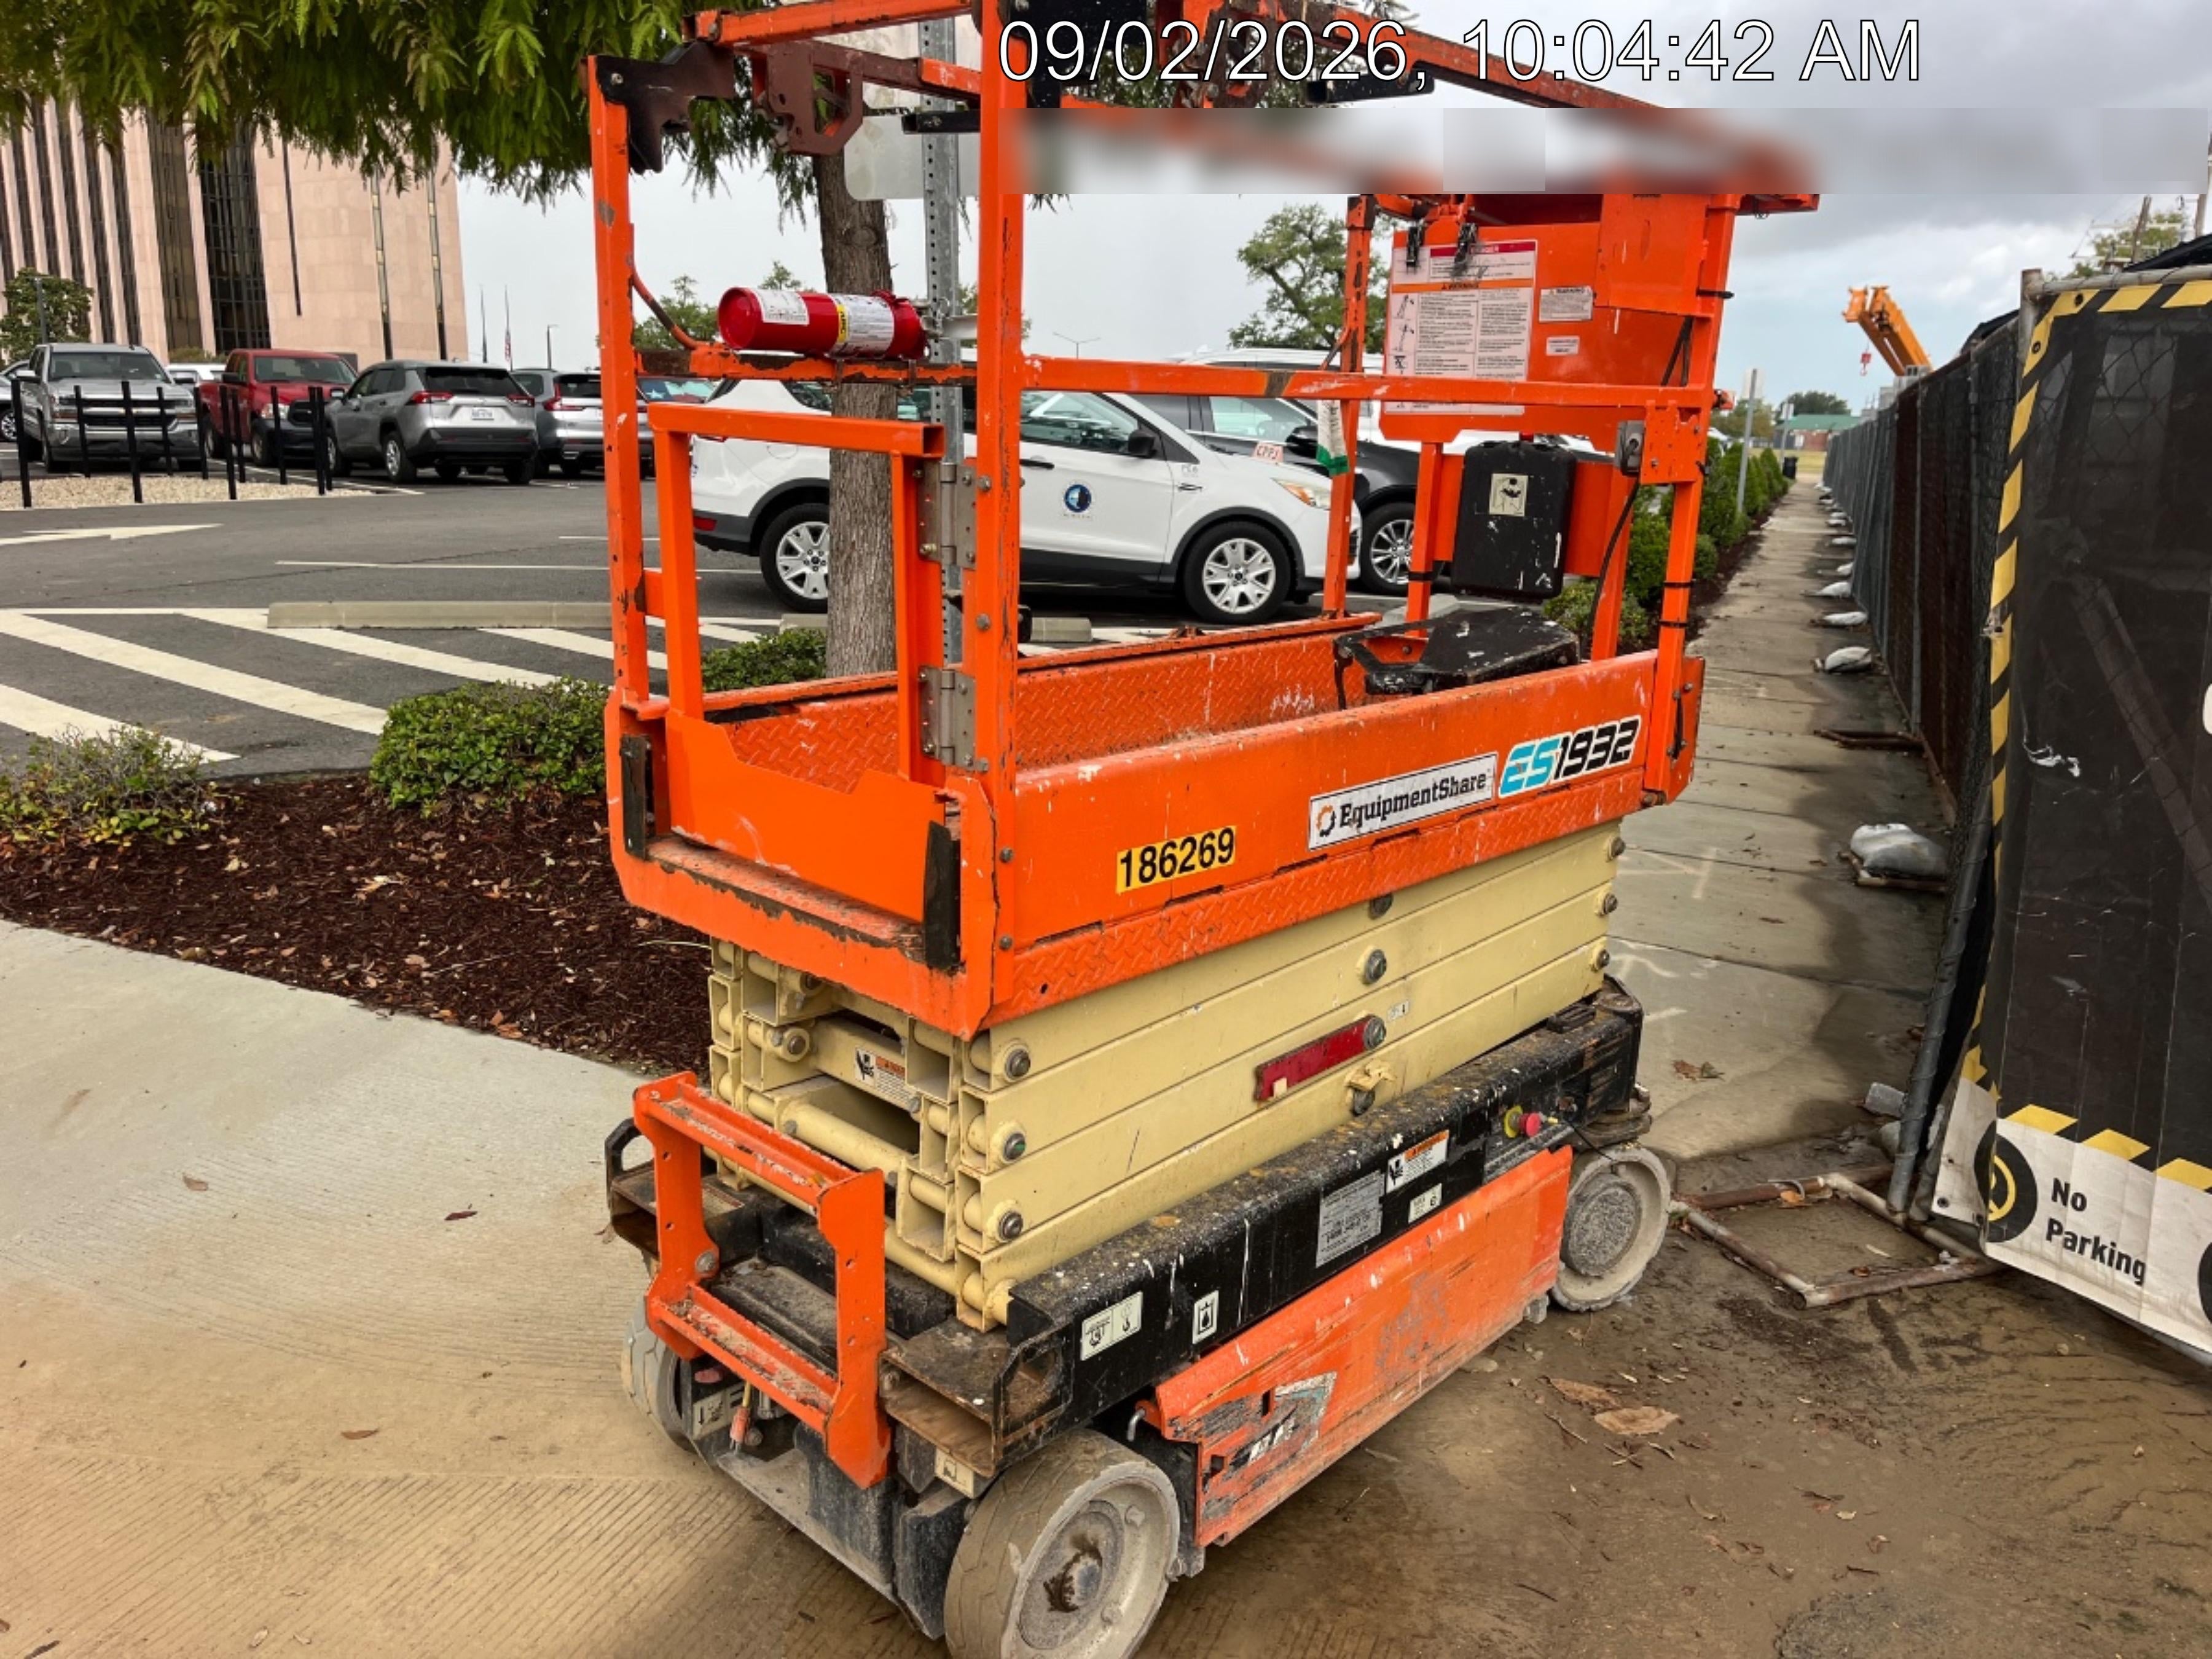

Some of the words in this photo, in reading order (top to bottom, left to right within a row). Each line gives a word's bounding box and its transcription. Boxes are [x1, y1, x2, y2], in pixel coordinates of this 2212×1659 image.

[1499, 718, 1640, 796] ES1932
[1340, 772, 1487, 828] EquipmentShare
[1120, 827, 1234, 888] 186269
[2051, 1177, 2087, 1212] No
[2045, 1217, 2146, 1286] Parking
